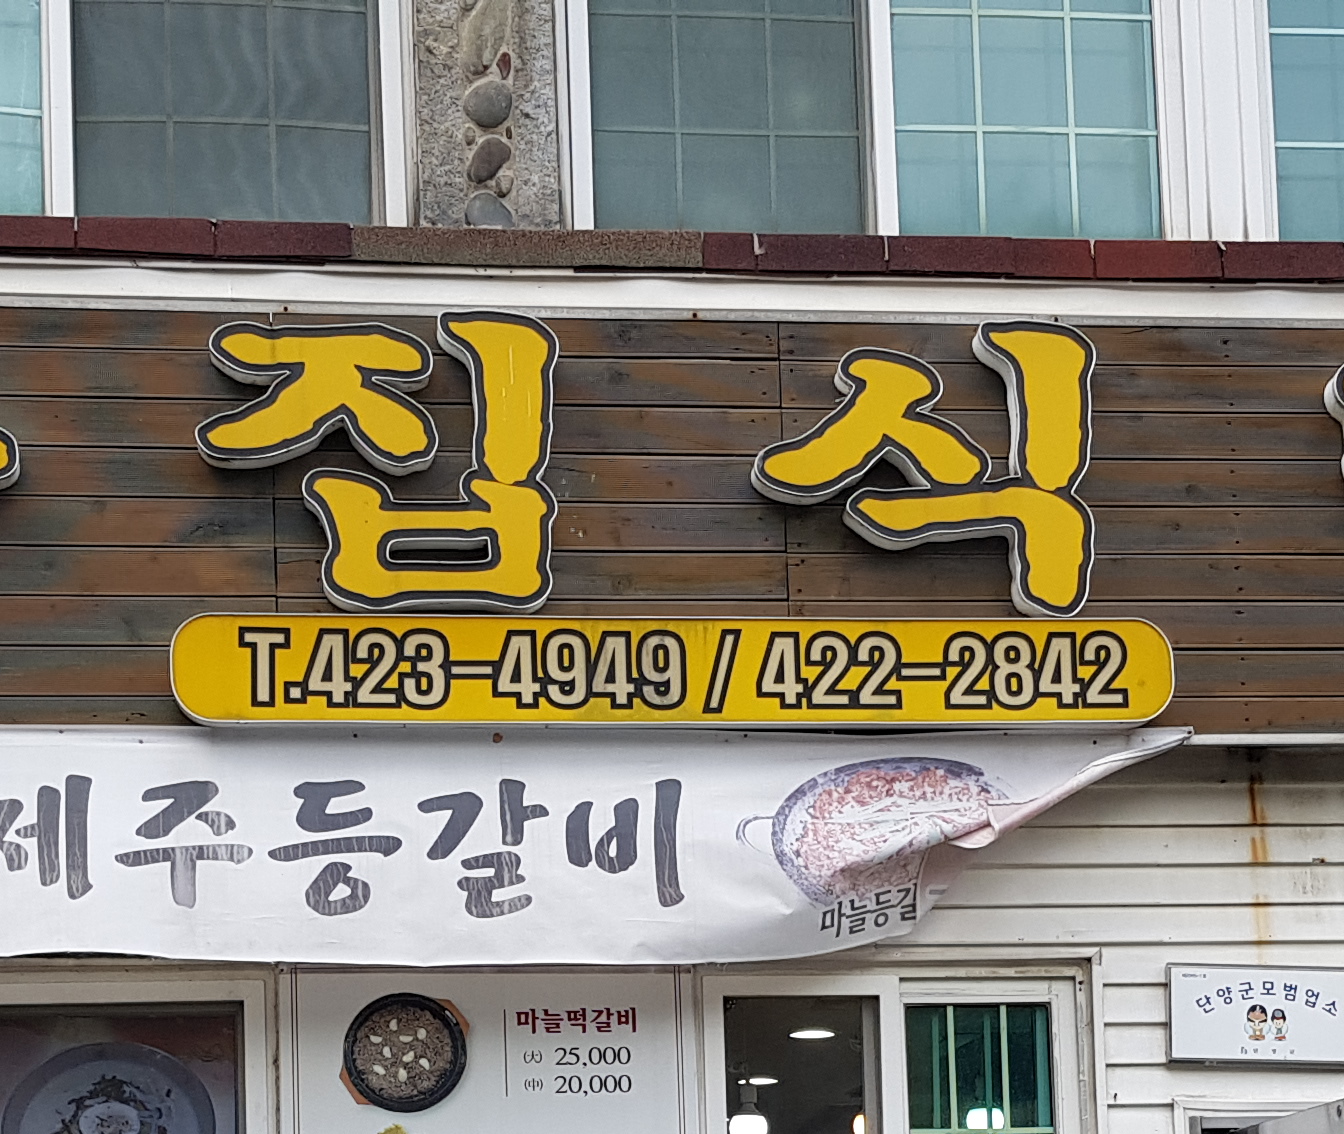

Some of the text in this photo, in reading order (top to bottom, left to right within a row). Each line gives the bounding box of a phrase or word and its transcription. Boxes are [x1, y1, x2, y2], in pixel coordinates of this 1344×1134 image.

[758, 631, 1130, 711] 422-2842
[1195, 980, 1339, 1017] 단양군모범업소
[514, 1006, 638, 1035] 마늘떡갈비
[553, 1045, 632, 1069] 25,000
[553, 1074, 633, 1098] 20,000
